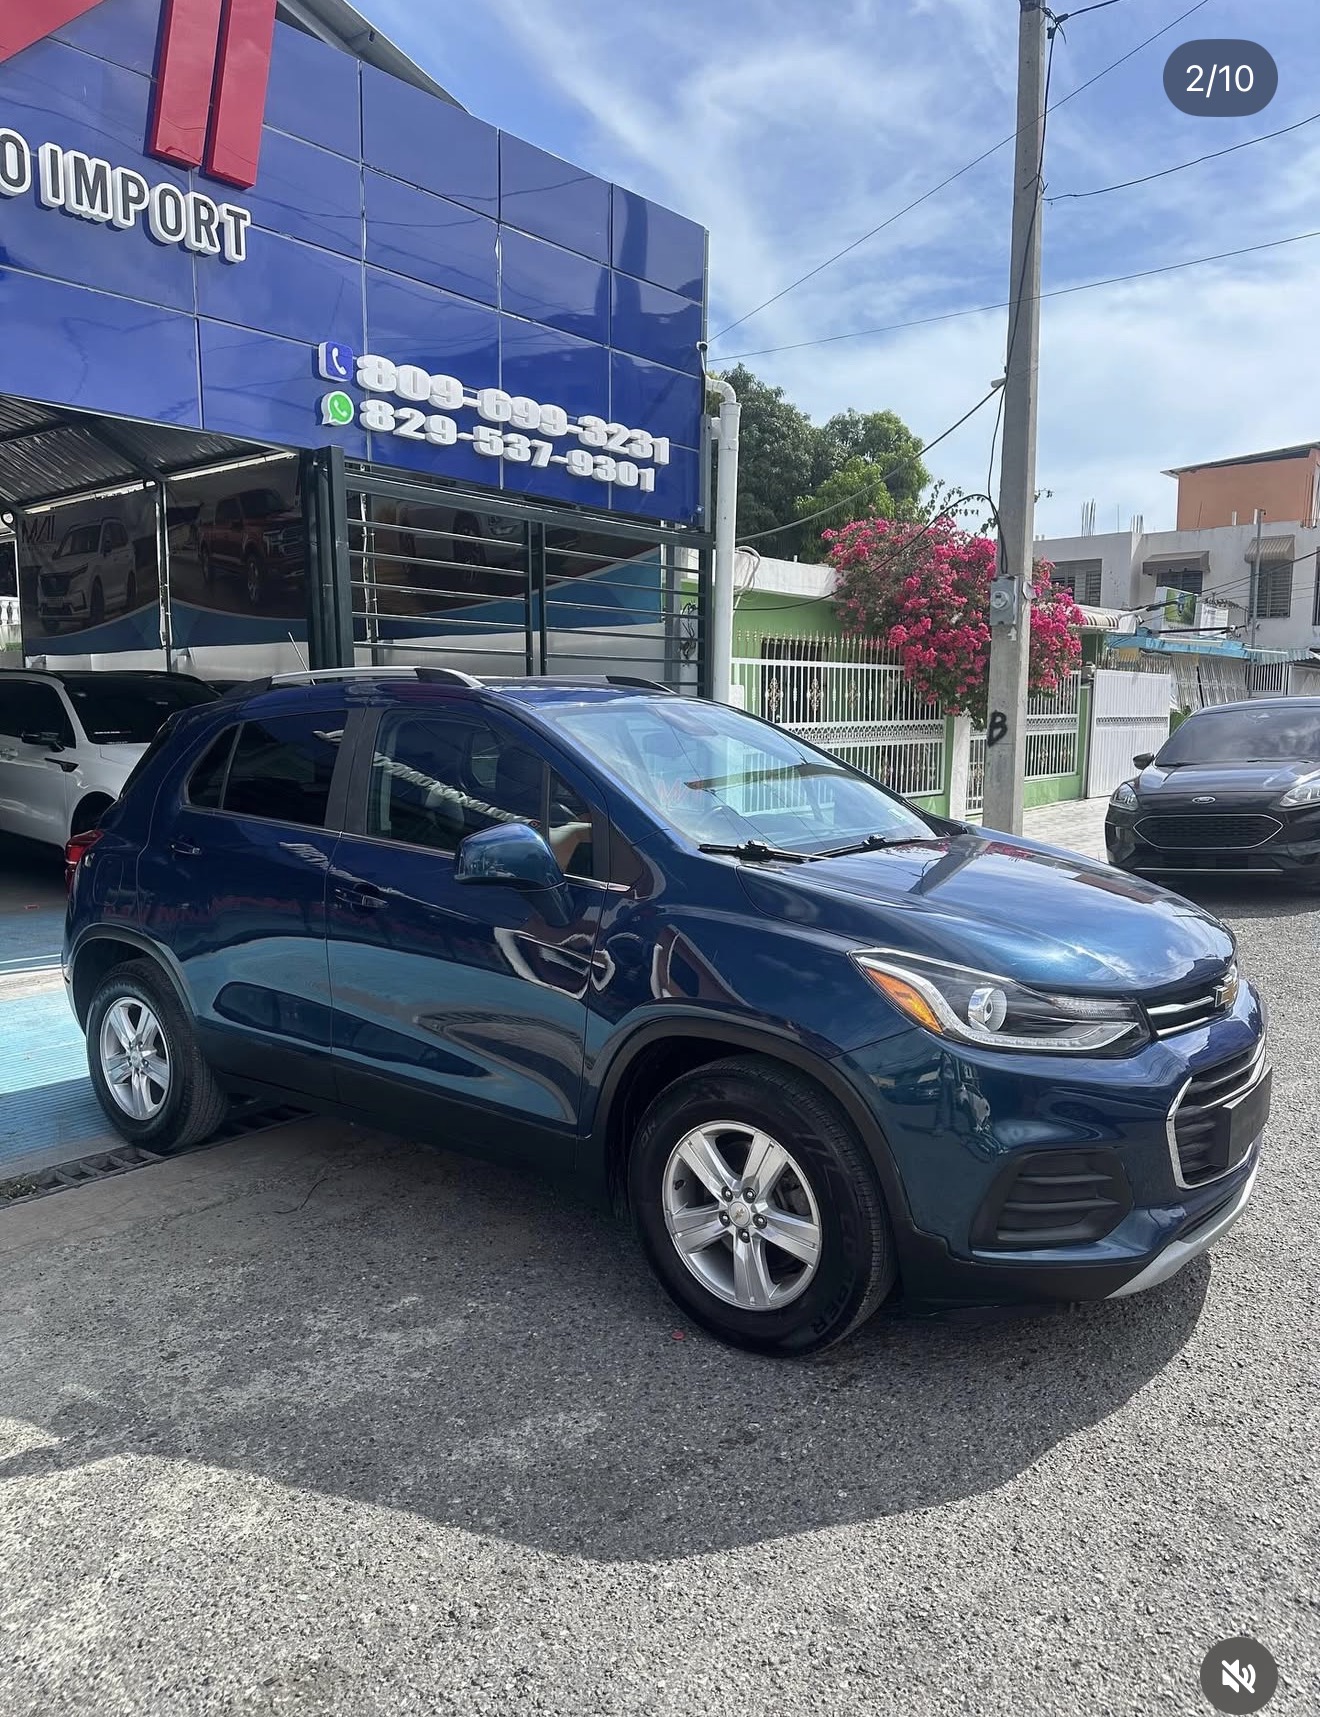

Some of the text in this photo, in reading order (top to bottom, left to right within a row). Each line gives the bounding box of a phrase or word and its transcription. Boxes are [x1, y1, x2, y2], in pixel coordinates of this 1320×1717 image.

[38, 142, 251, 263] IMPORT
[356, 354, 670, 465] 809-699-3231
[360, 399, 655, 492] 829-537-9301
[987, 709, 1008, 748] B
